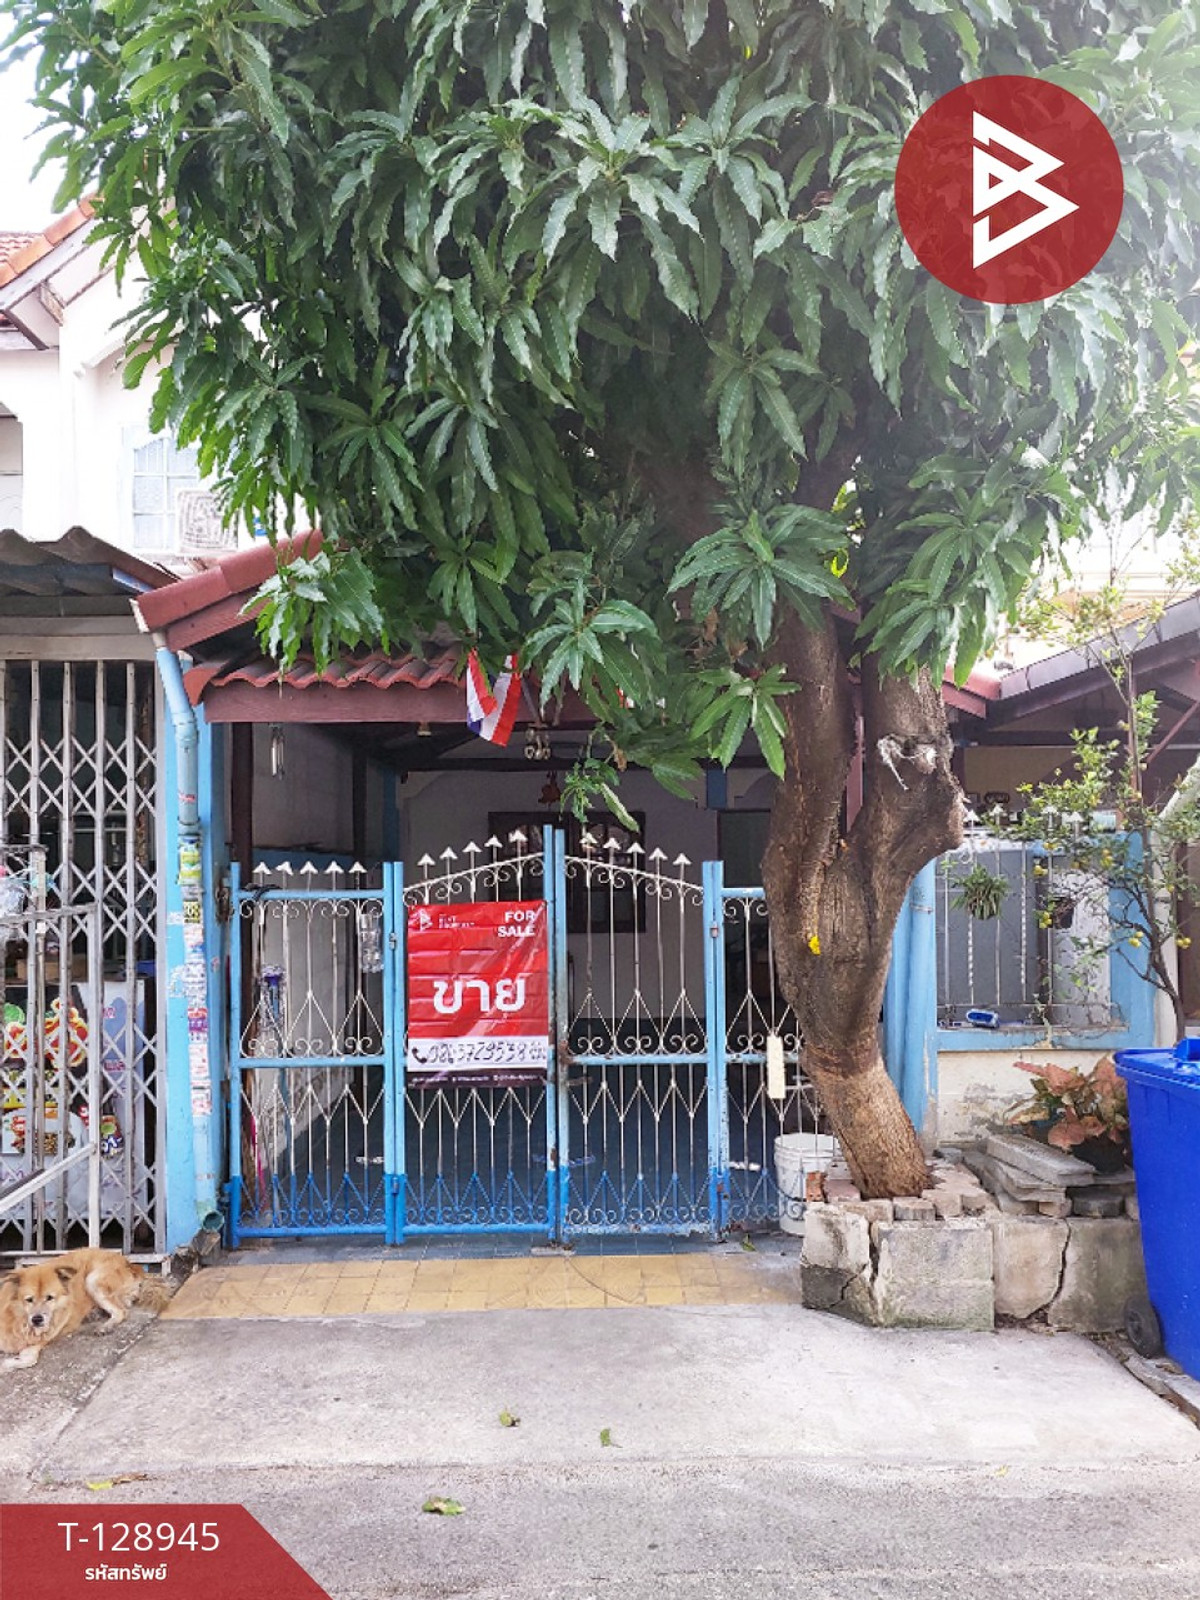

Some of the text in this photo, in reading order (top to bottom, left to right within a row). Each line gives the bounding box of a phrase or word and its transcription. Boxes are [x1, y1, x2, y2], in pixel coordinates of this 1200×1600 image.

[504, 910, 536, 923] FOR
[497, 925, 536, 938] SALE
[433, 977, 527, 1014] ขาย
